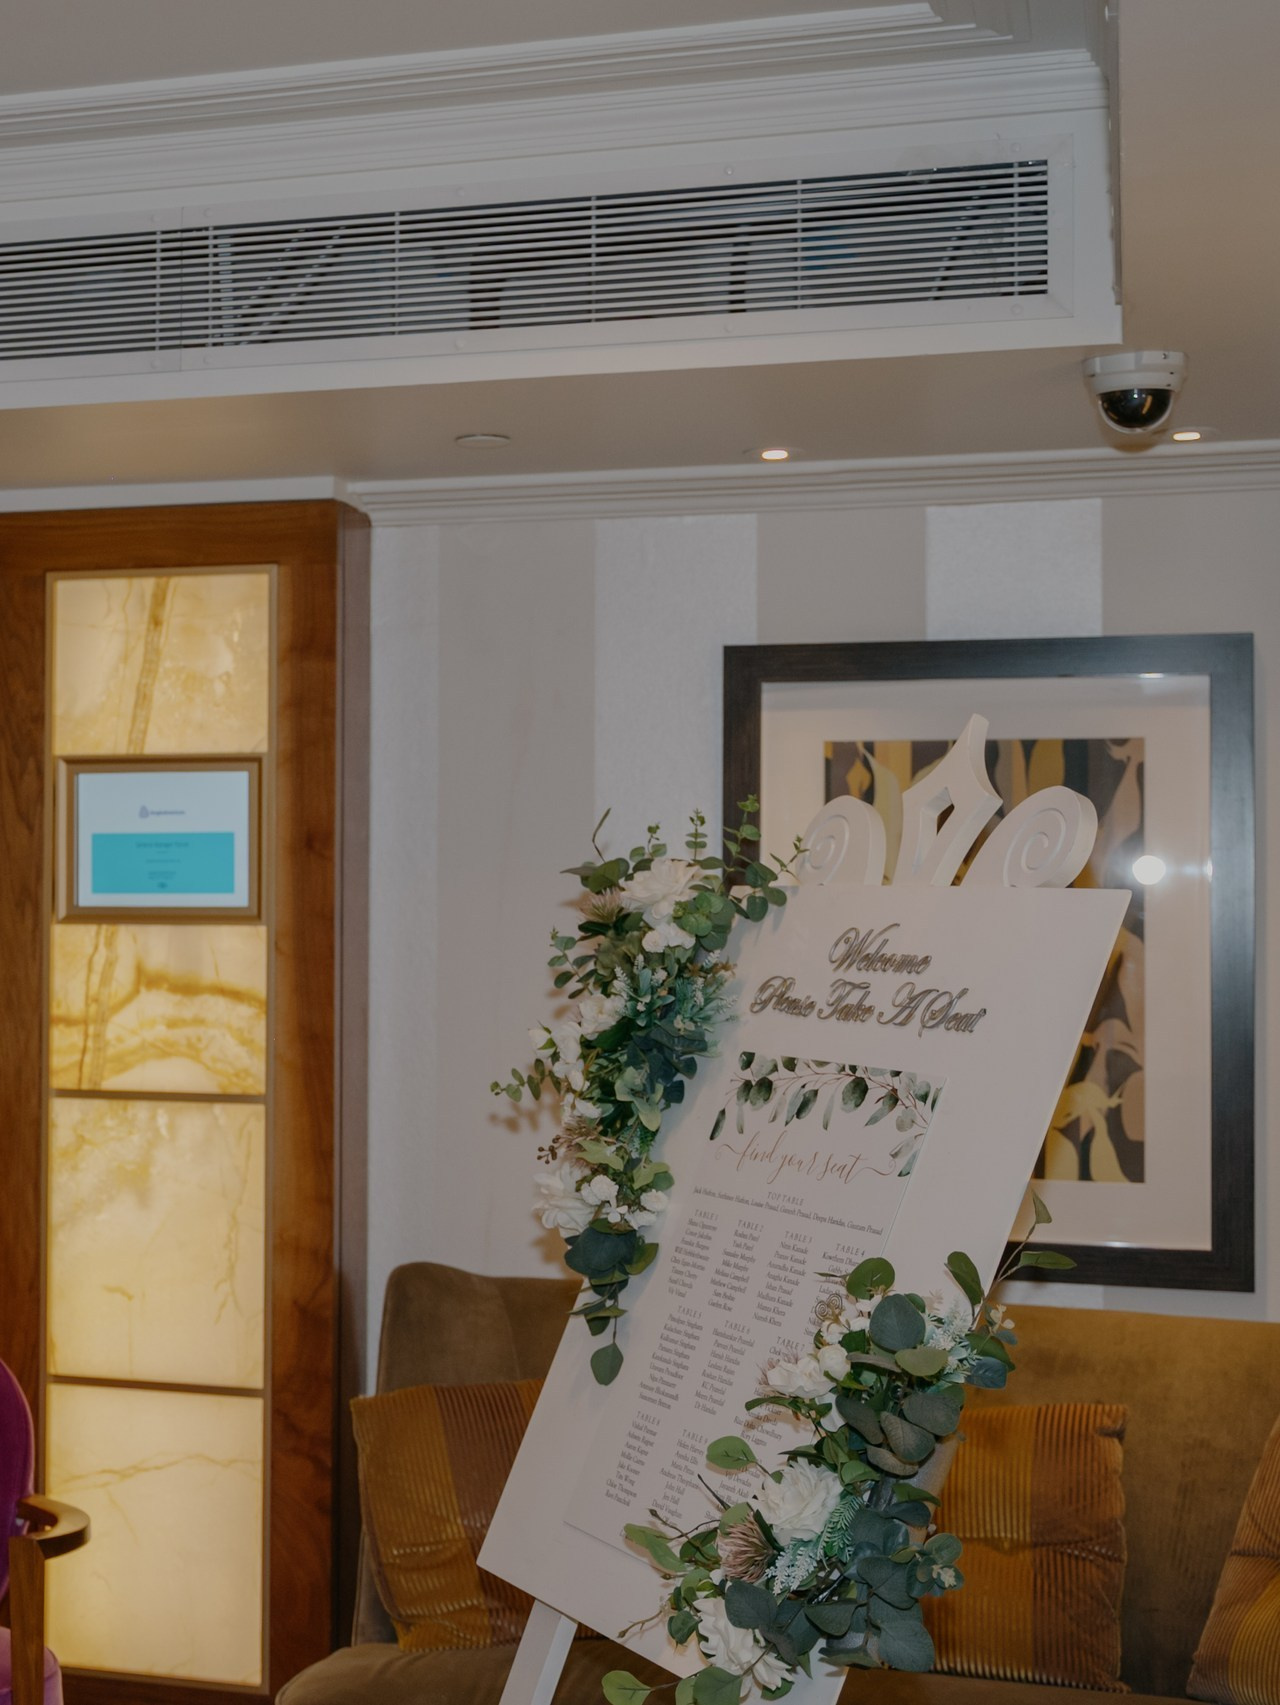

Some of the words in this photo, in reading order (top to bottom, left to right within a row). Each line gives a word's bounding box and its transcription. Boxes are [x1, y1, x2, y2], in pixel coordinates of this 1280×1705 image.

[829, 923, 932, 975] Welcome
[750, 976, 816, 1017] Please
[817, 979, 875, 1023] Take
[877, 982, 939, 1026] A
[918, 987, 987, 1039] Seat
